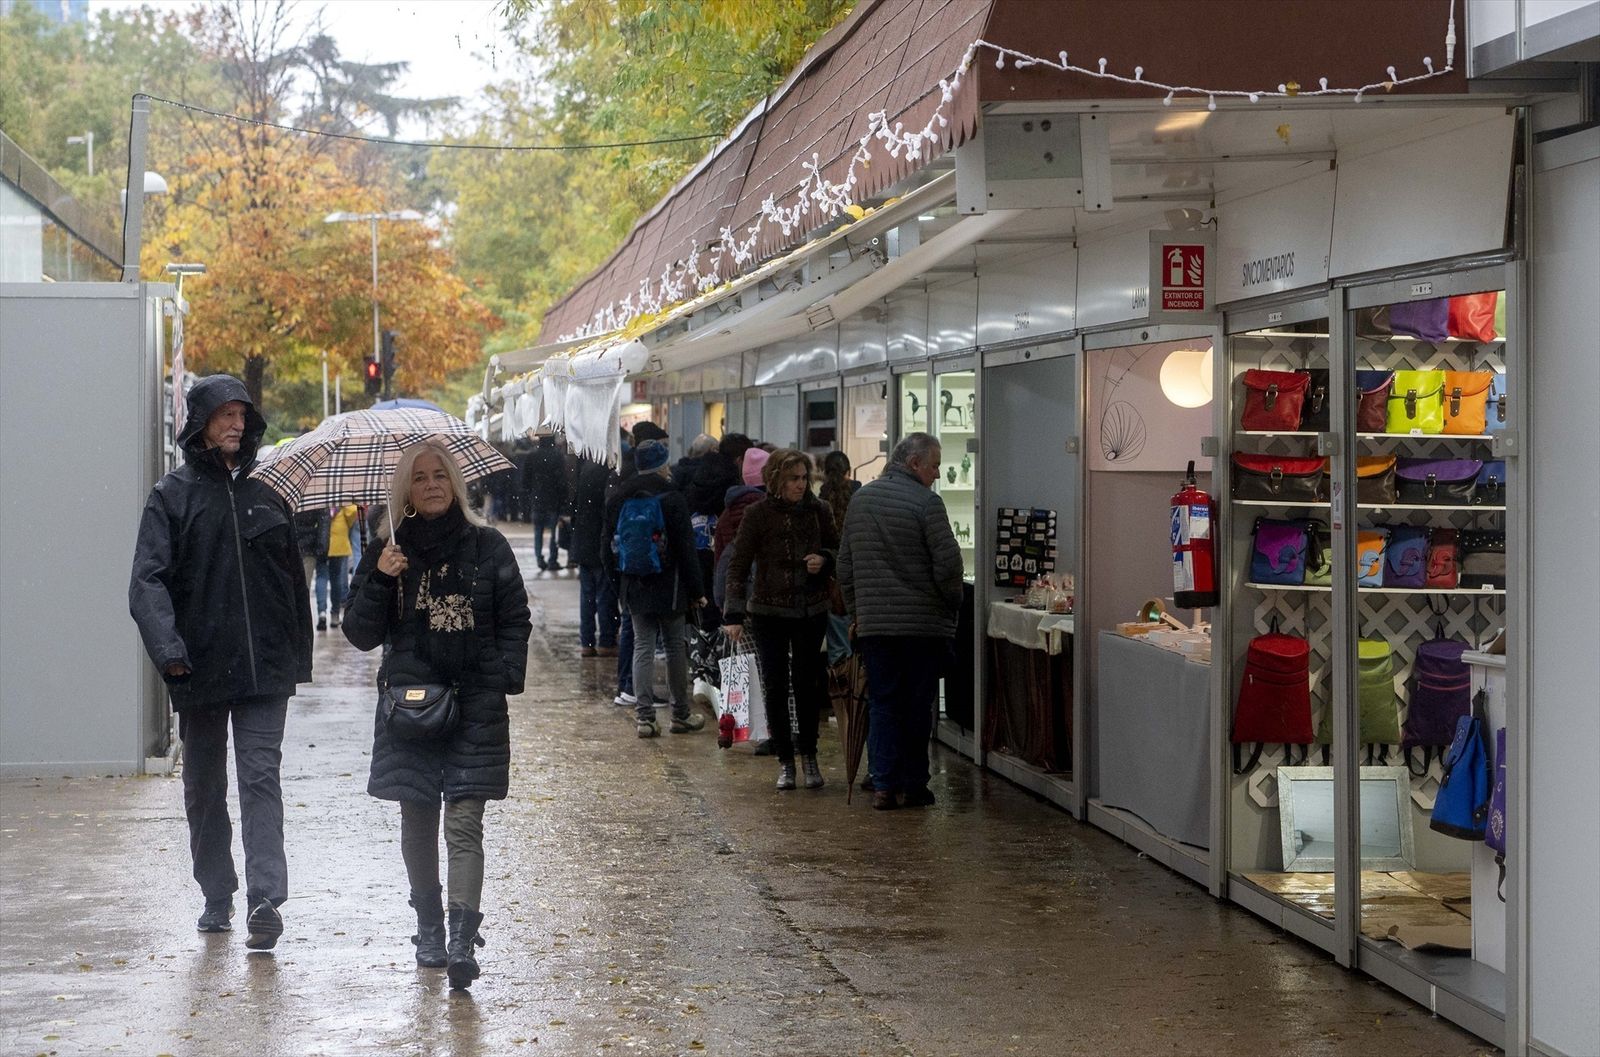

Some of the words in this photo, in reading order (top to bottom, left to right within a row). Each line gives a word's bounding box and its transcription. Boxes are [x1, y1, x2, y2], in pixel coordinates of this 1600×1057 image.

[1242, 251, 1295, 287] SINCOMENTARIOS
[1164, 292, 1193, 300] EXTINTOR
[1167, 300, 1200, 308] INCENDIOS
